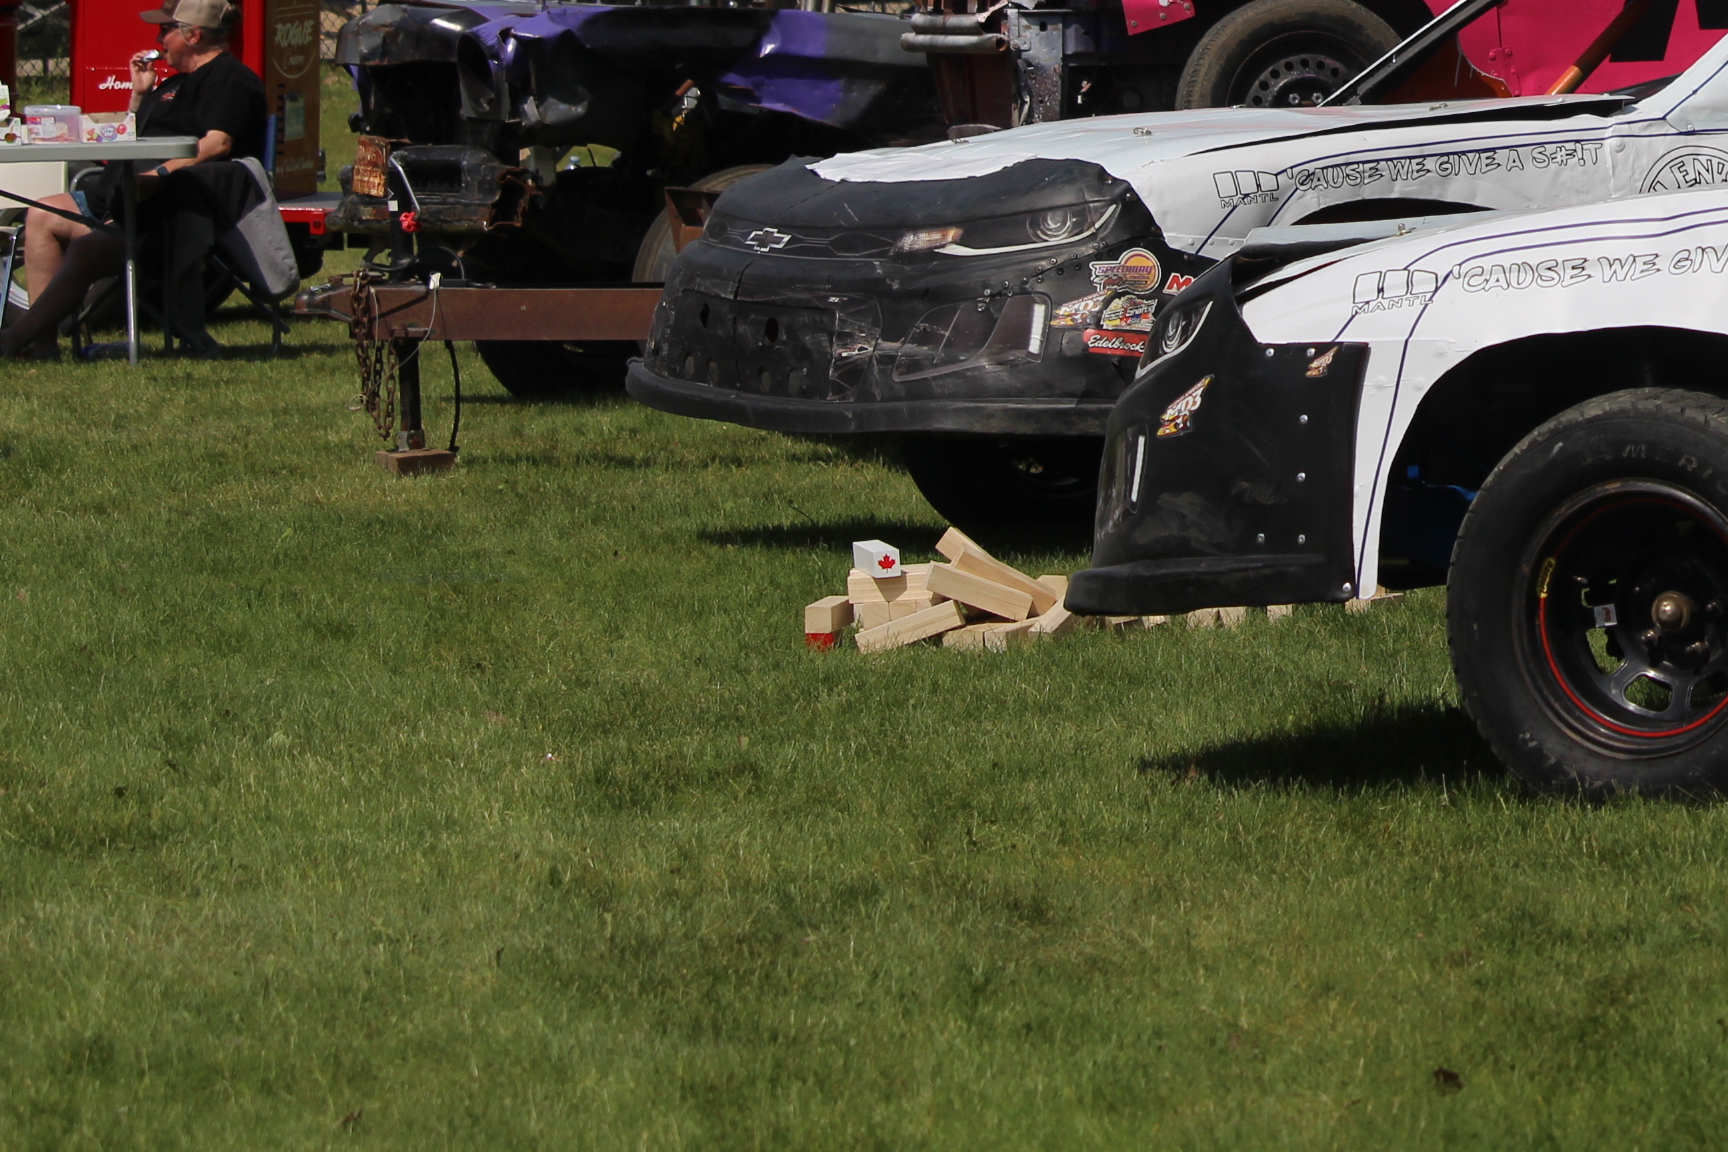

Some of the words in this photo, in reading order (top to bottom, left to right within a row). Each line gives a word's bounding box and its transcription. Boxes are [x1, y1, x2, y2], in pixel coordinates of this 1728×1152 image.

[275, 20, 315, 47] ROGUE
[1286, 153, 1383, 192] 'CAUSE
[1387, 156, 1431, 181] WE
[1434, 149, 1503, 177] GIVE
[1504, 152, 1525, 172] A
[1531, 141, 1603, 169] S#!T
[1220, 193, 1280, 209] MANTL
[1097, 264, 1153, 275] SPEEDWAY
[1452, 257, 1593, 294] 'CAUSE
[1597, 253, 1662, 284] WE
[1351, 295, 1434, 317] MANTL
[1088, 335, 1145, 353] Edelbrock
